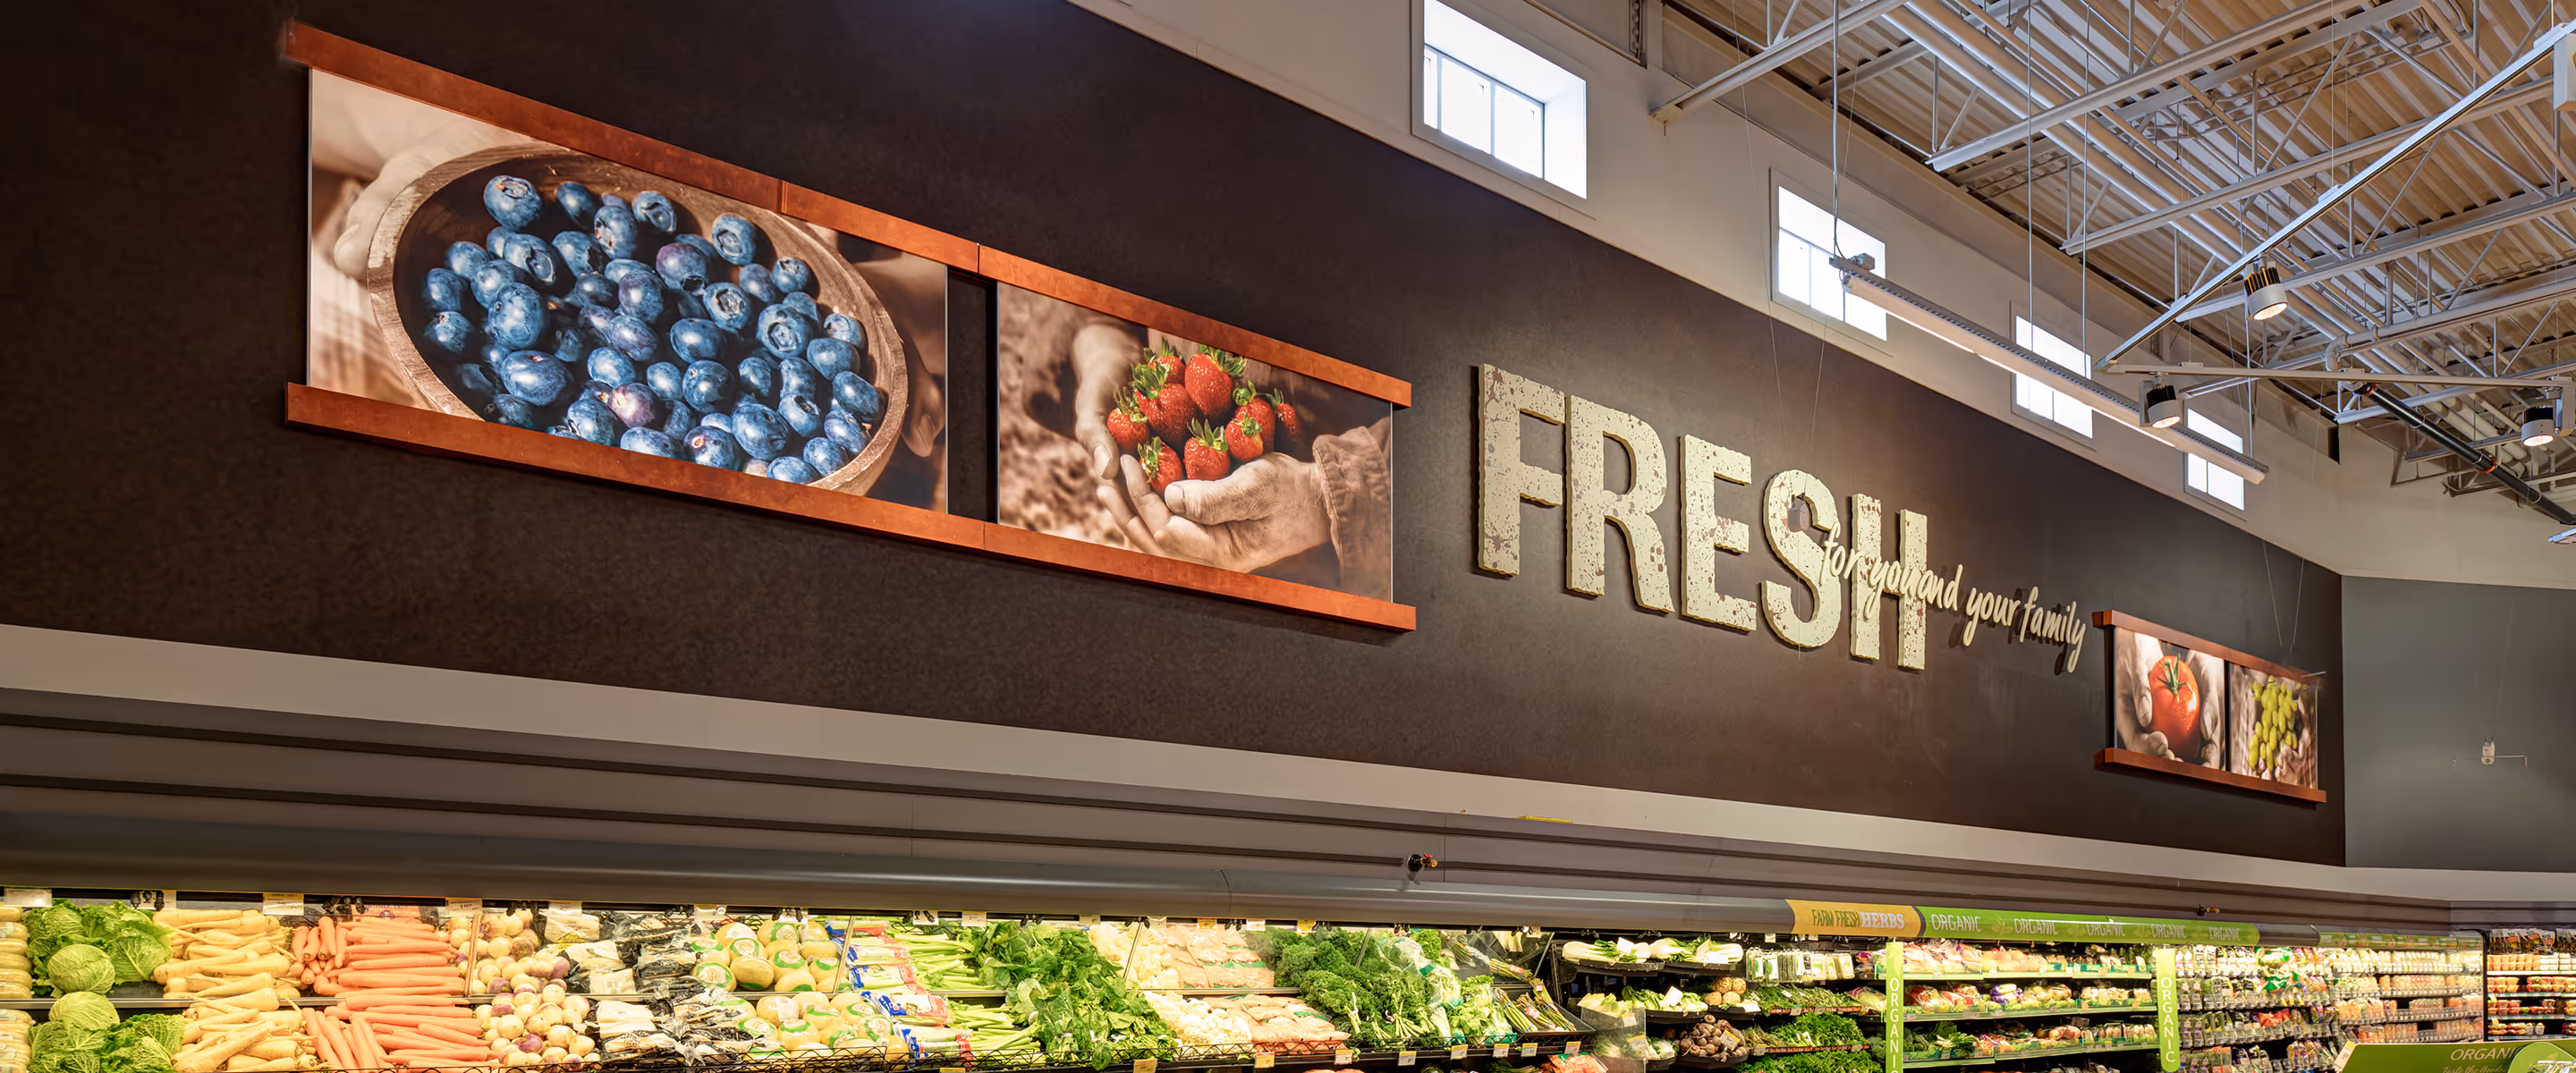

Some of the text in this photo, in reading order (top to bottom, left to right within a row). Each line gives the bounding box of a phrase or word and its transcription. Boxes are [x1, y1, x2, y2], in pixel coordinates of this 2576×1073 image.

[1478, 364, 1928, 670] FRESH
[1818, 522, 2087, 673] for you and your family
[1811, 908, 1905, 930] FARM FRESH HERBS
[1930, 914, 1983, 932] ORGANIC
[2013, 918, 2060, 935] ORGANIC
[2086, 922, 2126, 936] ORGANIC
[2150, 924, 2189, 939] ORGANIC
[2208, 926, 2241, 941] ORGANIC
[1889, 977, 1900, 1073] ORGANI
[2160, 976, 2176, 1062] ORGANIC
